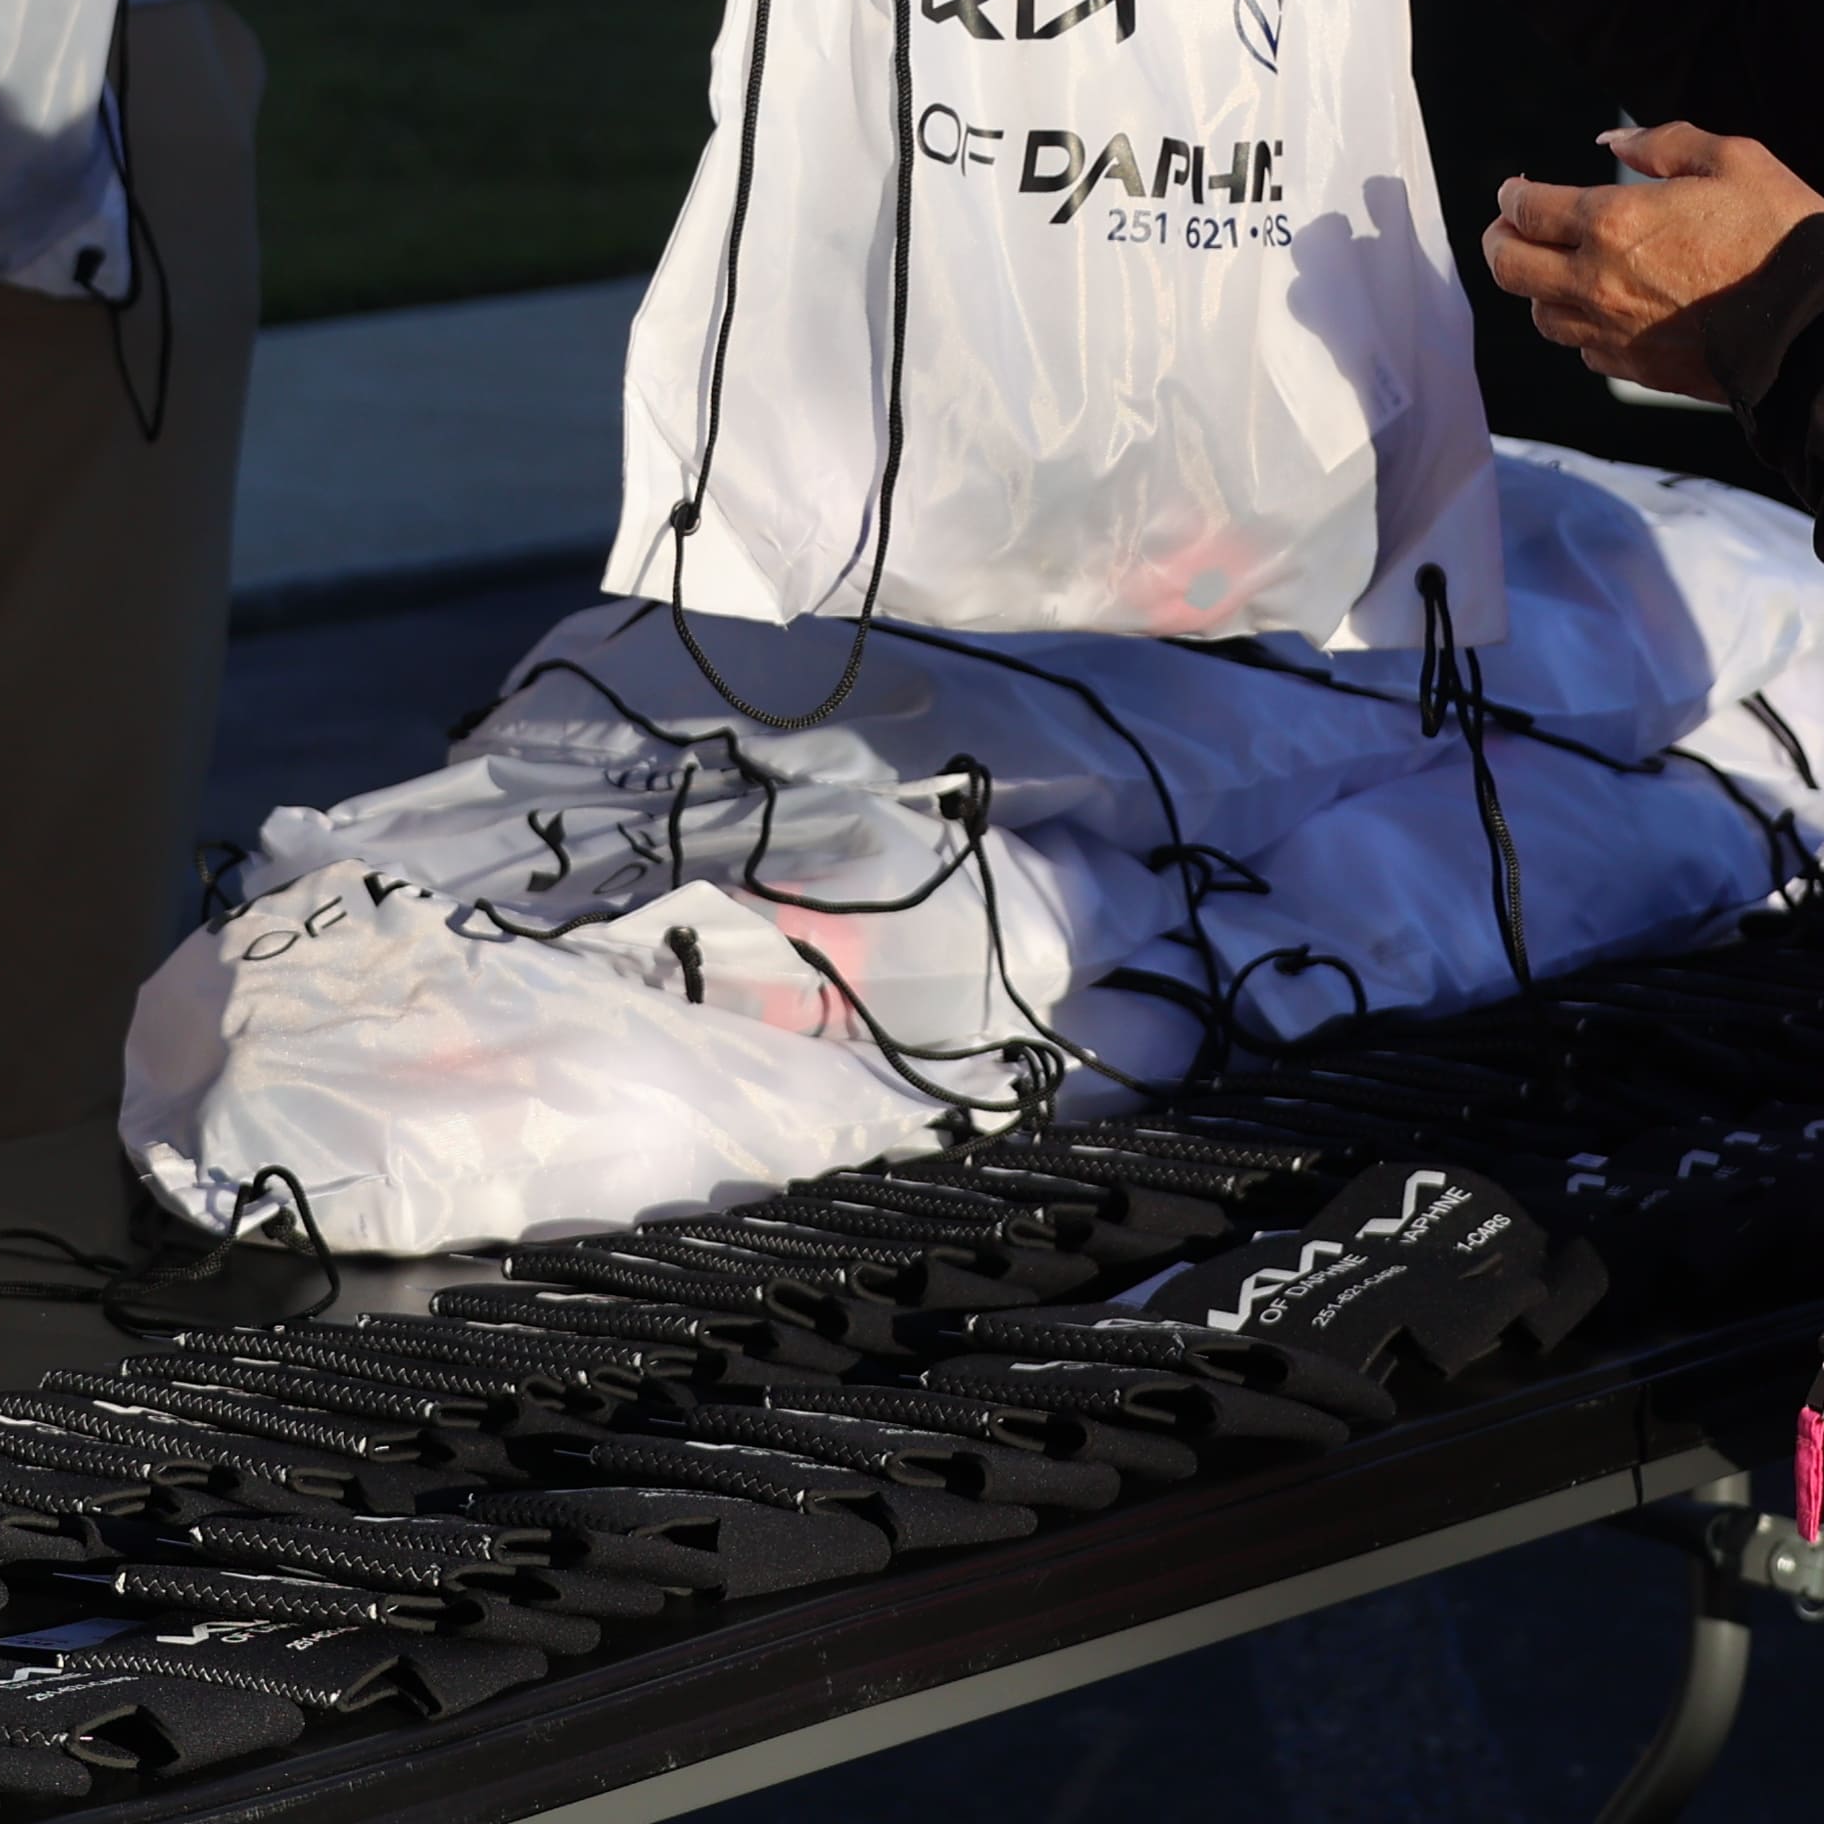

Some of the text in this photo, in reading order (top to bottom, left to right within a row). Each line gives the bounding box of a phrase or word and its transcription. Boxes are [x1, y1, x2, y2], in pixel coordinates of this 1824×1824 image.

[1400, 1185, 1473, 1245] APHNE
[1207, 1240, 1344, 1332] KIA
[1259, 1251, 1369, 1325] OF DAPHNE
